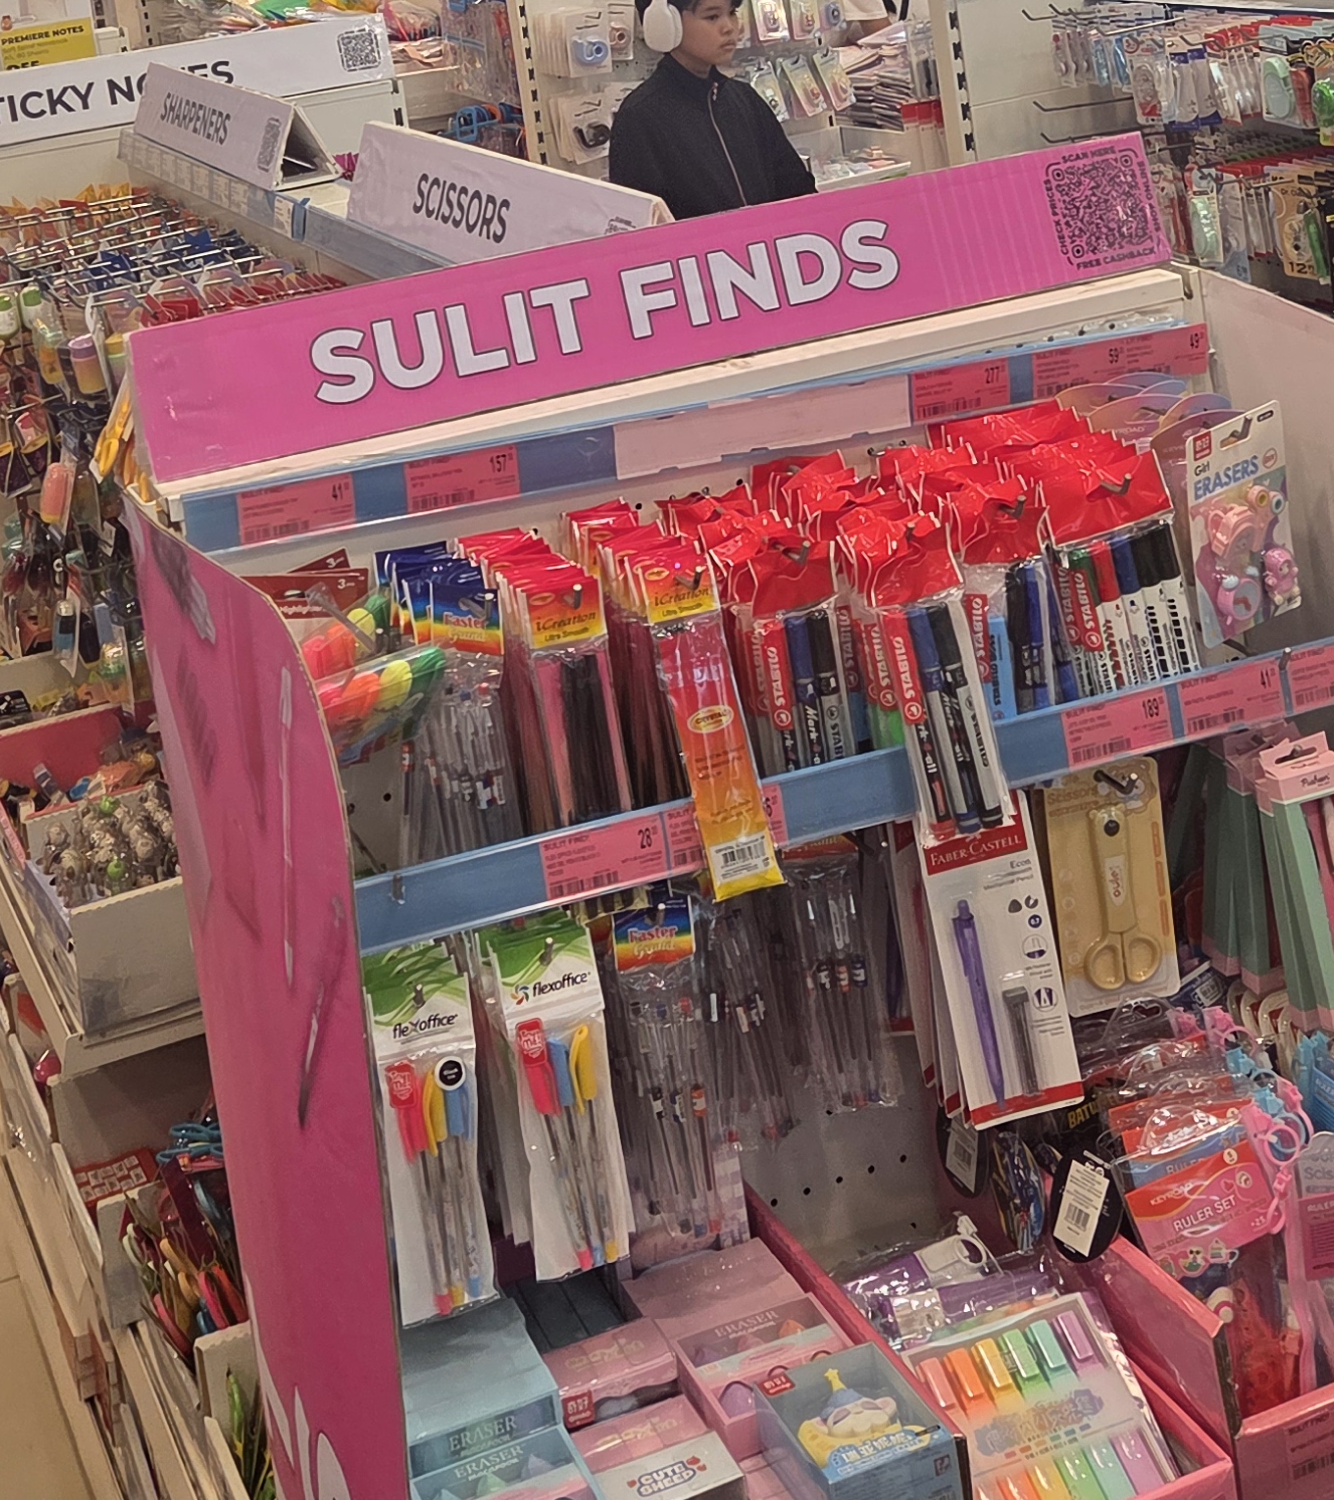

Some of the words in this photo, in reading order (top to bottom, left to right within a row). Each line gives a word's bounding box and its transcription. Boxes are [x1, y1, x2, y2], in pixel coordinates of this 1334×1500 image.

[1, 30, 51, 45] PREMIERE
[53, 24, 85, 38] NOTES
[160, 91, 231, 146] SHARPENERS
[1062, 152, 1089, 164] SCAN
[412, 172, 511, 243] SCISSORS
[1054, 219, 1069, 256] CHECK
[1076, 257, 1102, 270] FREE
[1103, 247, 1157, 264] CASHBACK
[310, 279, 590, 403] SULIT
[618, 219, 901, 340] FINDS
[1193, 453, 1260, 500] ERASERS
[654, 586, 710, 608] iCreation
[1075, 572, 1095, 630] STABILO
[535, 610, 597, 633] iCreation
[972, 597, 985, 659] STABILO
[768, 647, 786, 707] STABILO
[893, 637, 916, 700] STABILO
[930, 834, 1022, 867] FABER-CASTELL
[532, 971, 591, 999] flexoffice
[1173, 1206, 1215, 1232] RULER
[1215, 1195, 1238, 1218] SET
[714, 1309, 779, 1338] ERASER
[447, 1414, 517, 1454] ERASER
[454, 1444, 526, 1480] ERASER
[639, 1463, 685, 1484] CUTE
